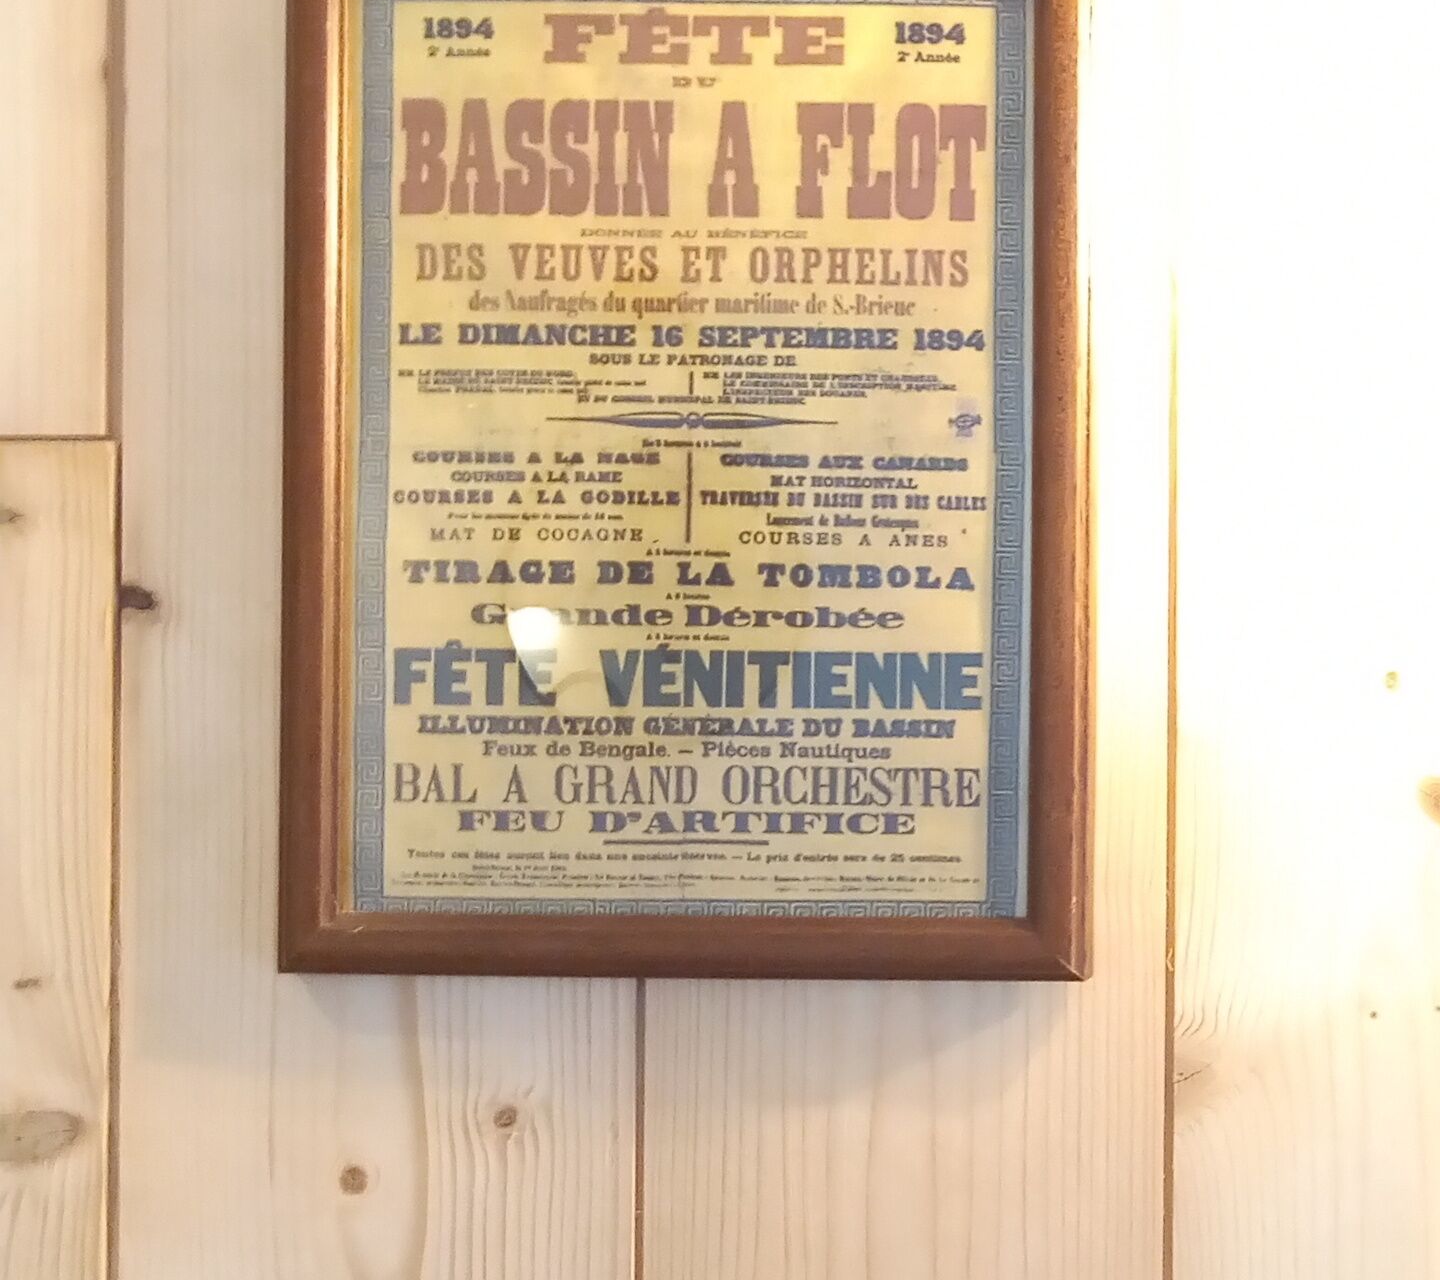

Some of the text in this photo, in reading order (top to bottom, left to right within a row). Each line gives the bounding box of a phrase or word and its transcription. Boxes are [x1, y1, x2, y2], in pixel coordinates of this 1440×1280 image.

[423, 16, 495, 40] 1894
[544, 7, 845, 66] FÊTE
[895, 21, 966, 46] 1894
[446, 45, 491, 58] Année
[915, 51, 961, 64] Année
[672, 76, 717, 88] DU
[399, 97, 988, 222] BASSIN A FLOT
[671, 228, 698, 238] AU
[415, 242, 969, 288] DES VEUVES ET ORPHELINS
[469, 289, 500, 312] des
[603, 291, 627, 313] du
[632, 290, 709, 320] quartier
[715, 292, 800, 315] maritime
[805, 292, 828, 315] de
[399, 322, 986, 352] LE DIMANCHE 16 SEPTEMBRE 1894
[588, 353, 797, 367] SOUS LE PATRONAGE DE
[412, 451, 516, 465] COURSES
[554, 451, 585, 465] LA
[597, 452, 661, 465] NAGE
[818, 455, 864, 470] AUX
[451, 470, 526, 483] COURSES
[547, 471, 570, 483] LA
[770, 475, 918, 490] MAT HORIZONTAL
[393, 489, 495, 505] COURSES
[537, 490, 567, 505] LA
[786, 491, 806, 508] DU
[813, 492, 864, 509] BASSIN
[871, 493, 897, 510] SUR
[905, 494, 931, 511] DES
[430, 527, 645, 543] MAT DE COCAGNE
[738, 531, 843, 546] COURSES
[402, 559, 976, 591] TIRAGE DE LA TOMBOLA
[470, 603, 906, 629] Gnde Dérobée
[393, 639, 984, 711] FÊTE VÉNITIENNE
[417, 713, 957, 740] ILLUMINATION GÉNÉRALE DU BASSIN
[482, 740, 538, 757] Feux
[545, 740, 572, 757] de
[701, 740, 772, 759] Pièces
[779, 741, 892, 763] Nautiques
[392, 762, 982, 808] BAL A GRAND ORCHESTRE
[457, 809, 917, 836] FEU D'ARTIFICE
